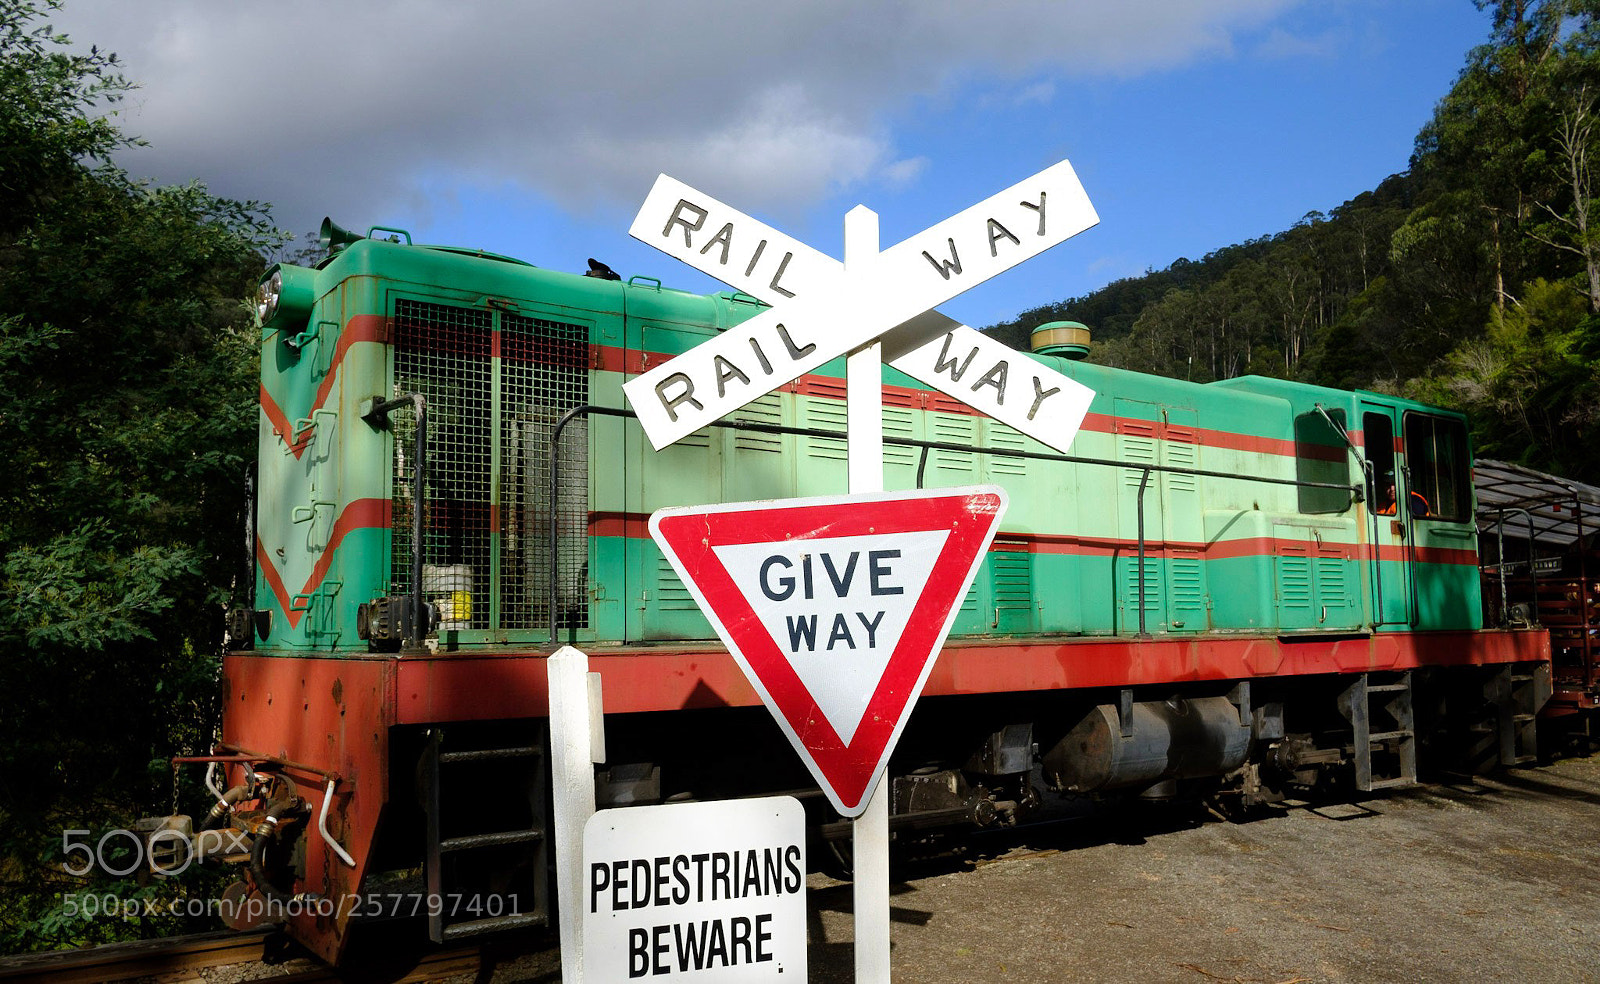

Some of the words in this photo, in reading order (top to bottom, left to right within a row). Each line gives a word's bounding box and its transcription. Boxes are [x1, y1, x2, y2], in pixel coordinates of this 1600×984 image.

[655, 323, 816, 422] RAIL
[922, 191, 1047, 280] WAY
[663, 199, 796, 298] RAIL
[933, 332, 1060, 421] WAY
[759, 549, 904, 601] GIVE
[786, 611, 886, 653] WAY
[590, 845, 801, 913] PEDESTRIANS
